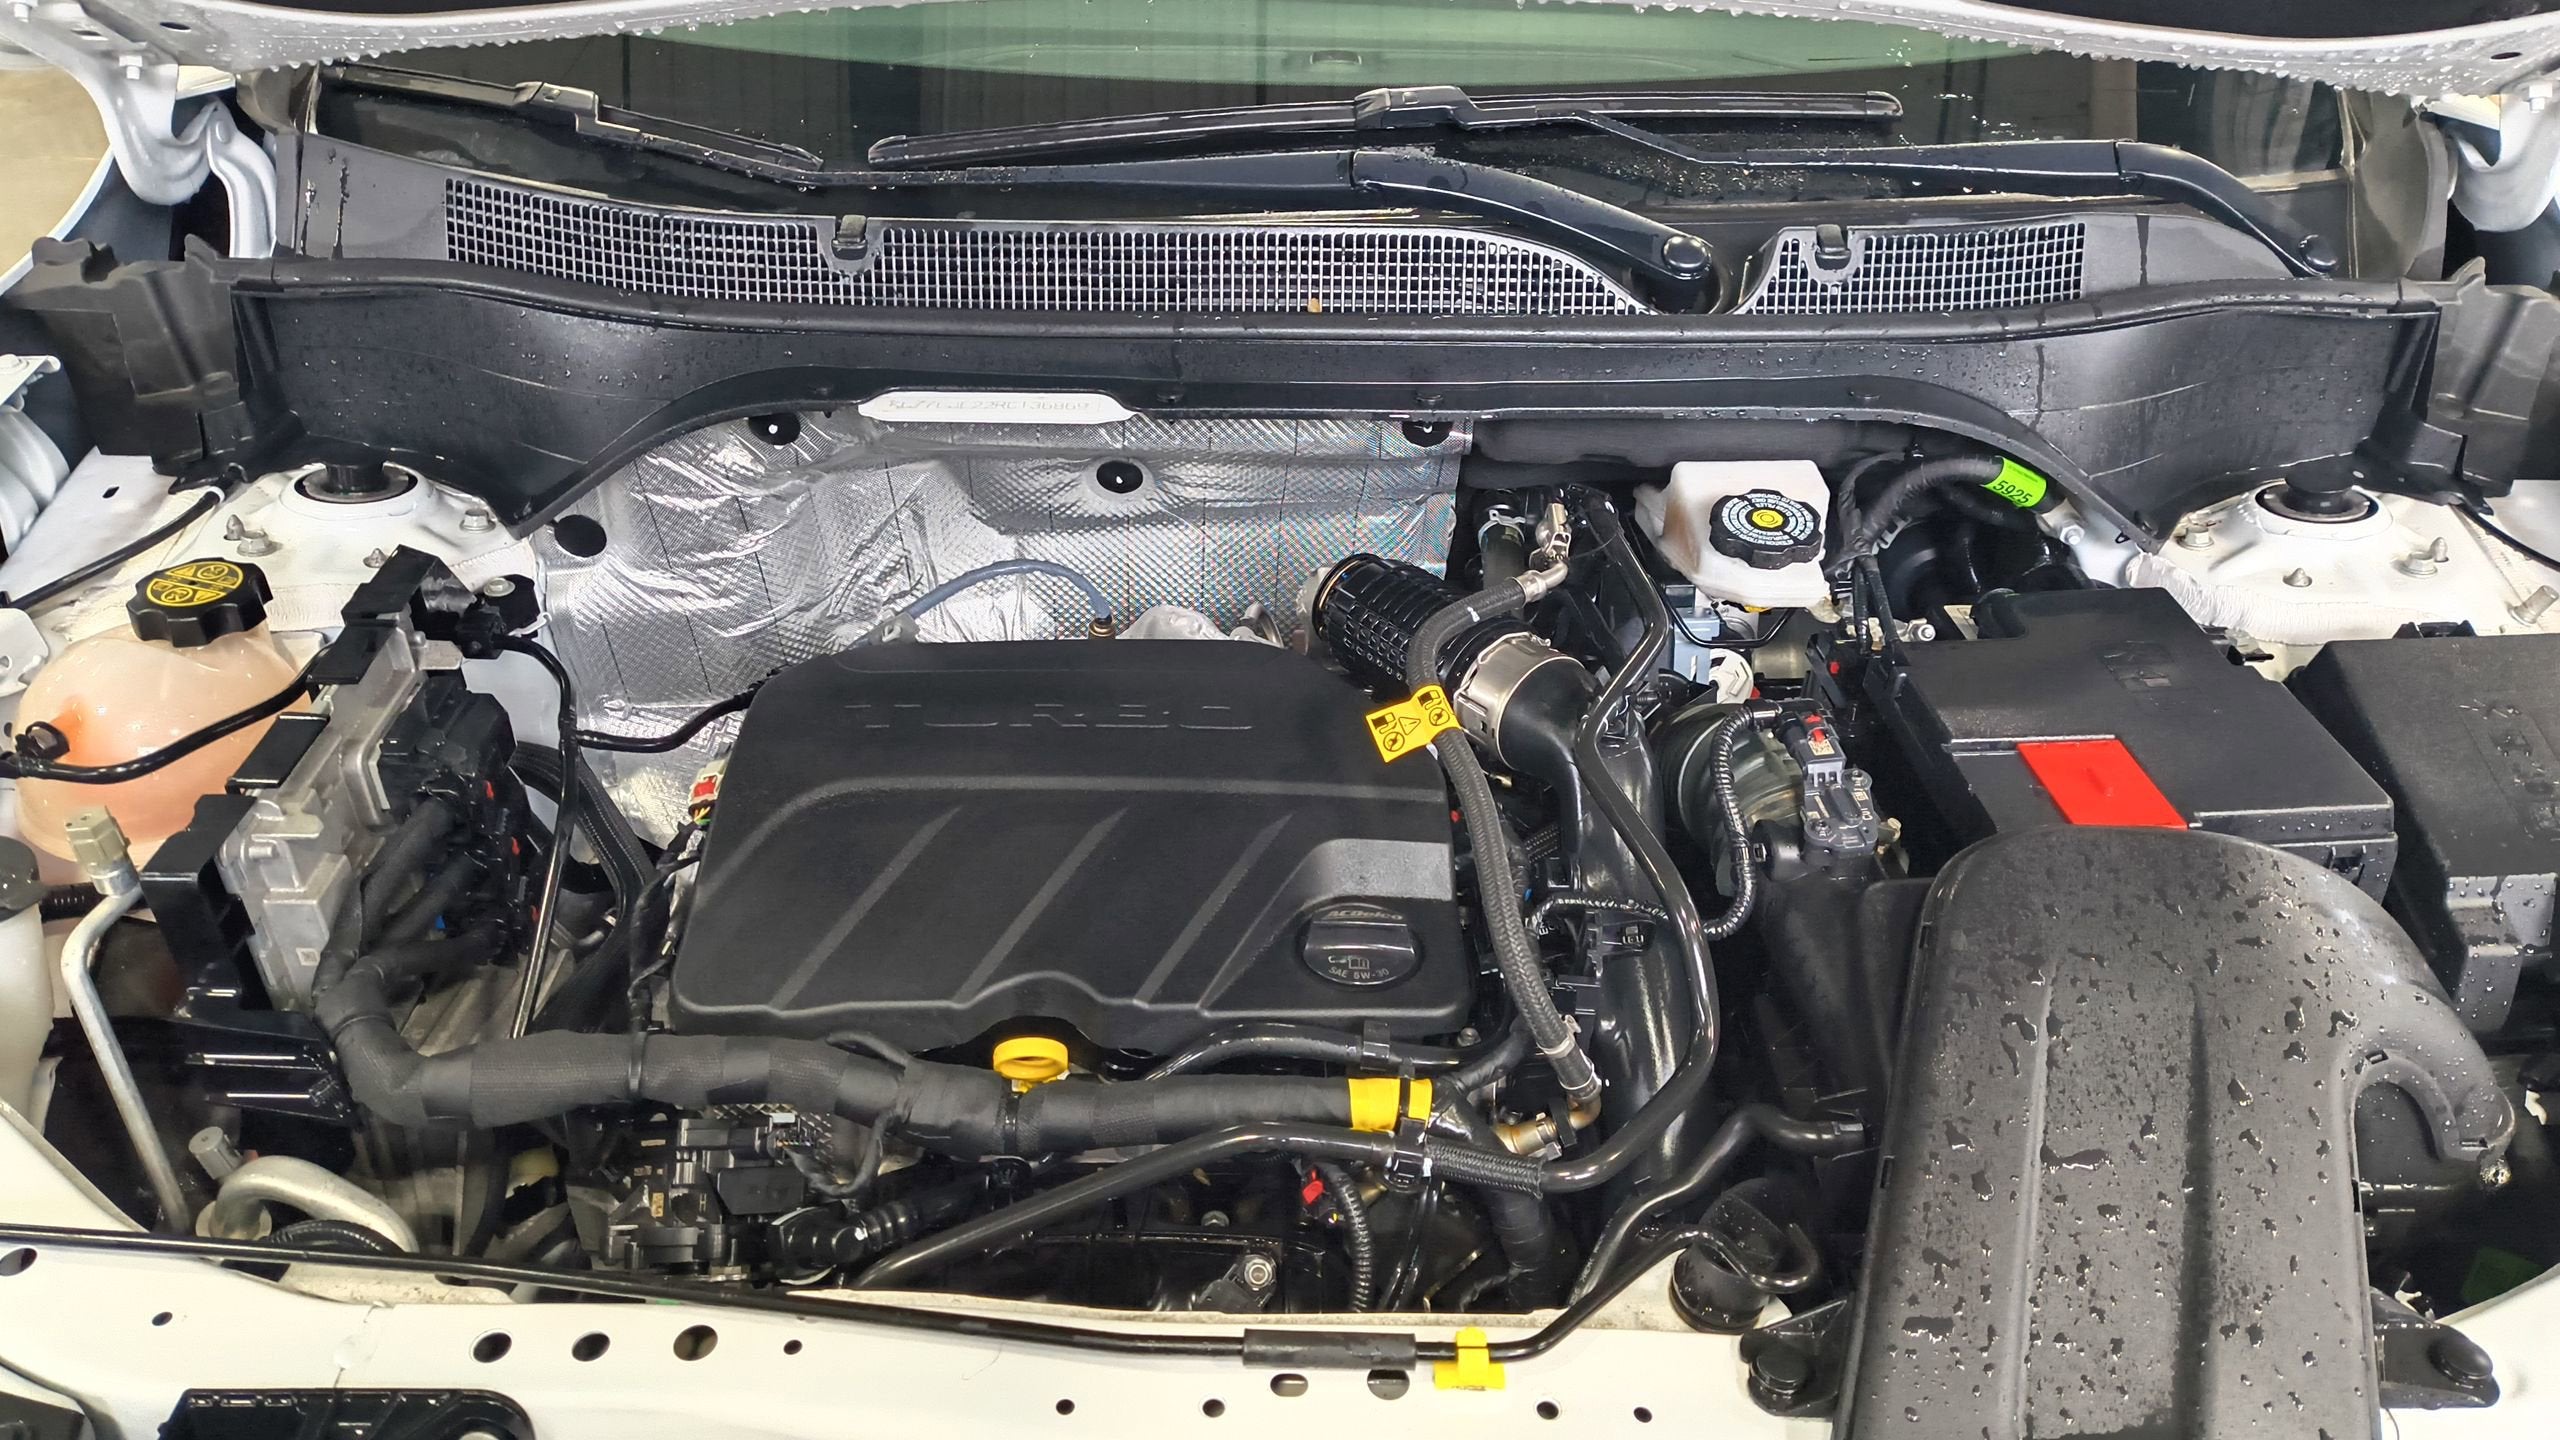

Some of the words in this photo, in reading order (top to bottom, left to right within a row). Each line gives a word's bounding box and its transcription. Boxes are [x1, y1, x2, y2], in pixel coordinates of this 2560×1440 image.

[1993, 480, 2033, 503] 5925
[844, 703, 1253, 730] TURBO
[1322, 909, 1404, 922] ACDelco
[1328, 966, 1348, 978] SAE
[1353, 967, 1390, 980] 5W-30
